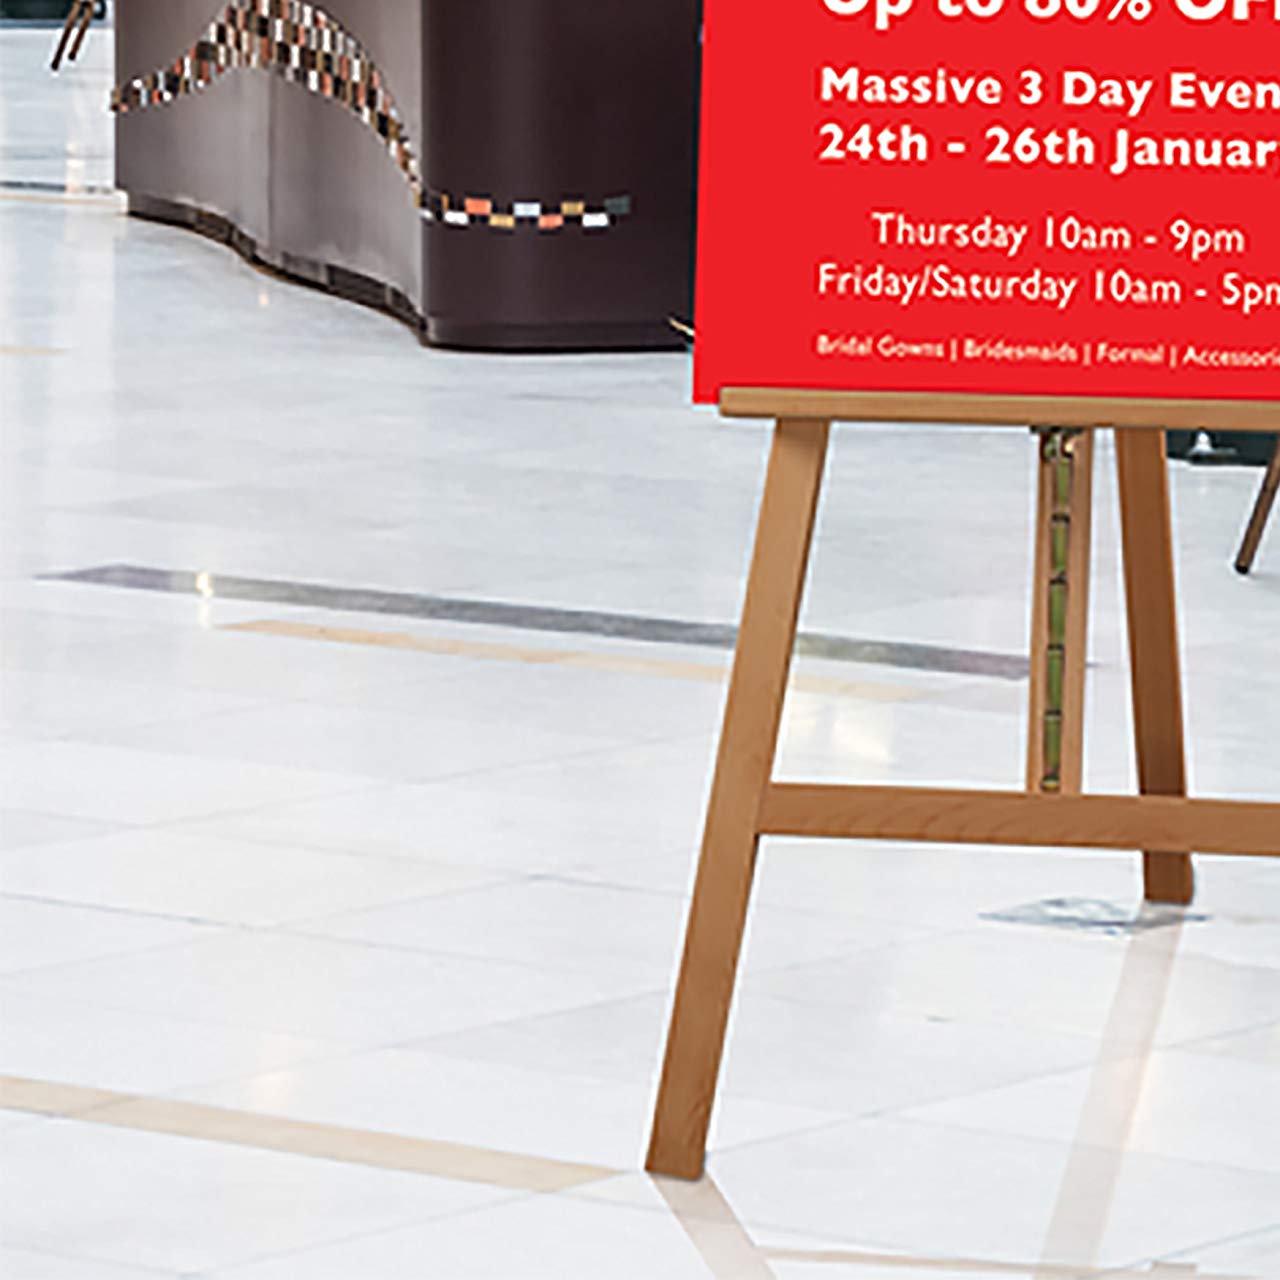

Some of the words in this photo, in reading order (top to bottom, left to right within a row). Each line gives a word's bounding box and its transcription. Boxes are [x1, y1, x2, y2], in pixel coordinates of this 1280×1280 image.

[821, 66, 1002, 105] Massive
[1019, 69, 1042, 105] 3
[1062, 71, 1153, 117] Day
[819, 123, 927, 161] 24th
[985, 126, 1095, 165] 26th
[871, 212, 1028, 257] Thursday
[1045, 216, 1131, 249] 10am
[1170, 219, 1244, 261] 9pm
[819, 262, 1077, 309] Friday/Saturday
[1095, 269, 1181, 303] 10am
[817, 334, 873, 355] Bridal
[877, 335, 944, 357] Gowns
[964, 339, 1077, 362] Bridesmaids
[1097, 343, 1164, 363] Formal
